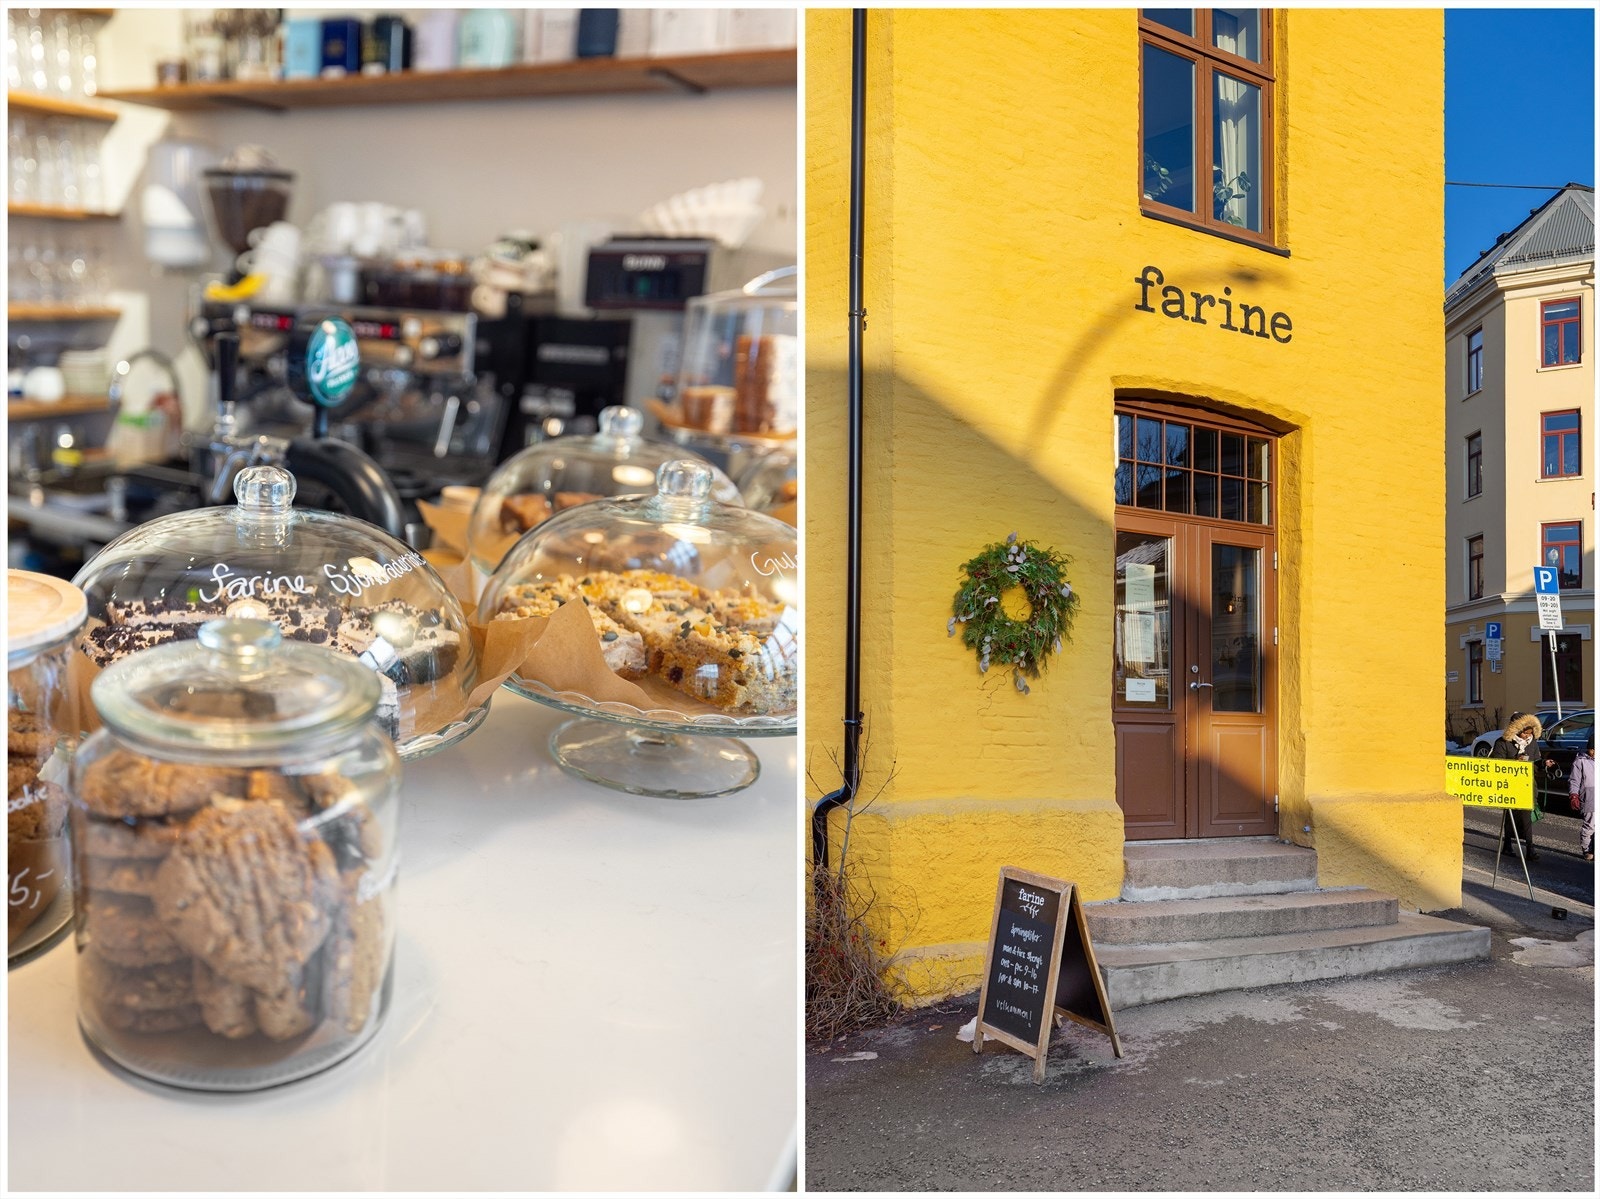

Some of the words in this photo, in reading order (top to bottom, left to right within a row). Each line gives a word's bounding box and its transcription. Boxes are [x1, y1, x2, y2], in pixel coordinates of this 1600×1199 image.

[1134, 265, 1293, 344] farine
[199, 562, 314, 603] farine
[1539, 570, 1553, 591] P
[1489, 624, 1498, 637] P
[1446, 760, 1490, 774] ennligst
[1494, 763, 1529, 777] benytt
[1460, 776, 1492, 788] fortau
[1496, 779, 1509, 790] på
[1488, 793, 1516, 804] siden
[1018, 888, 1045, 906] farine
